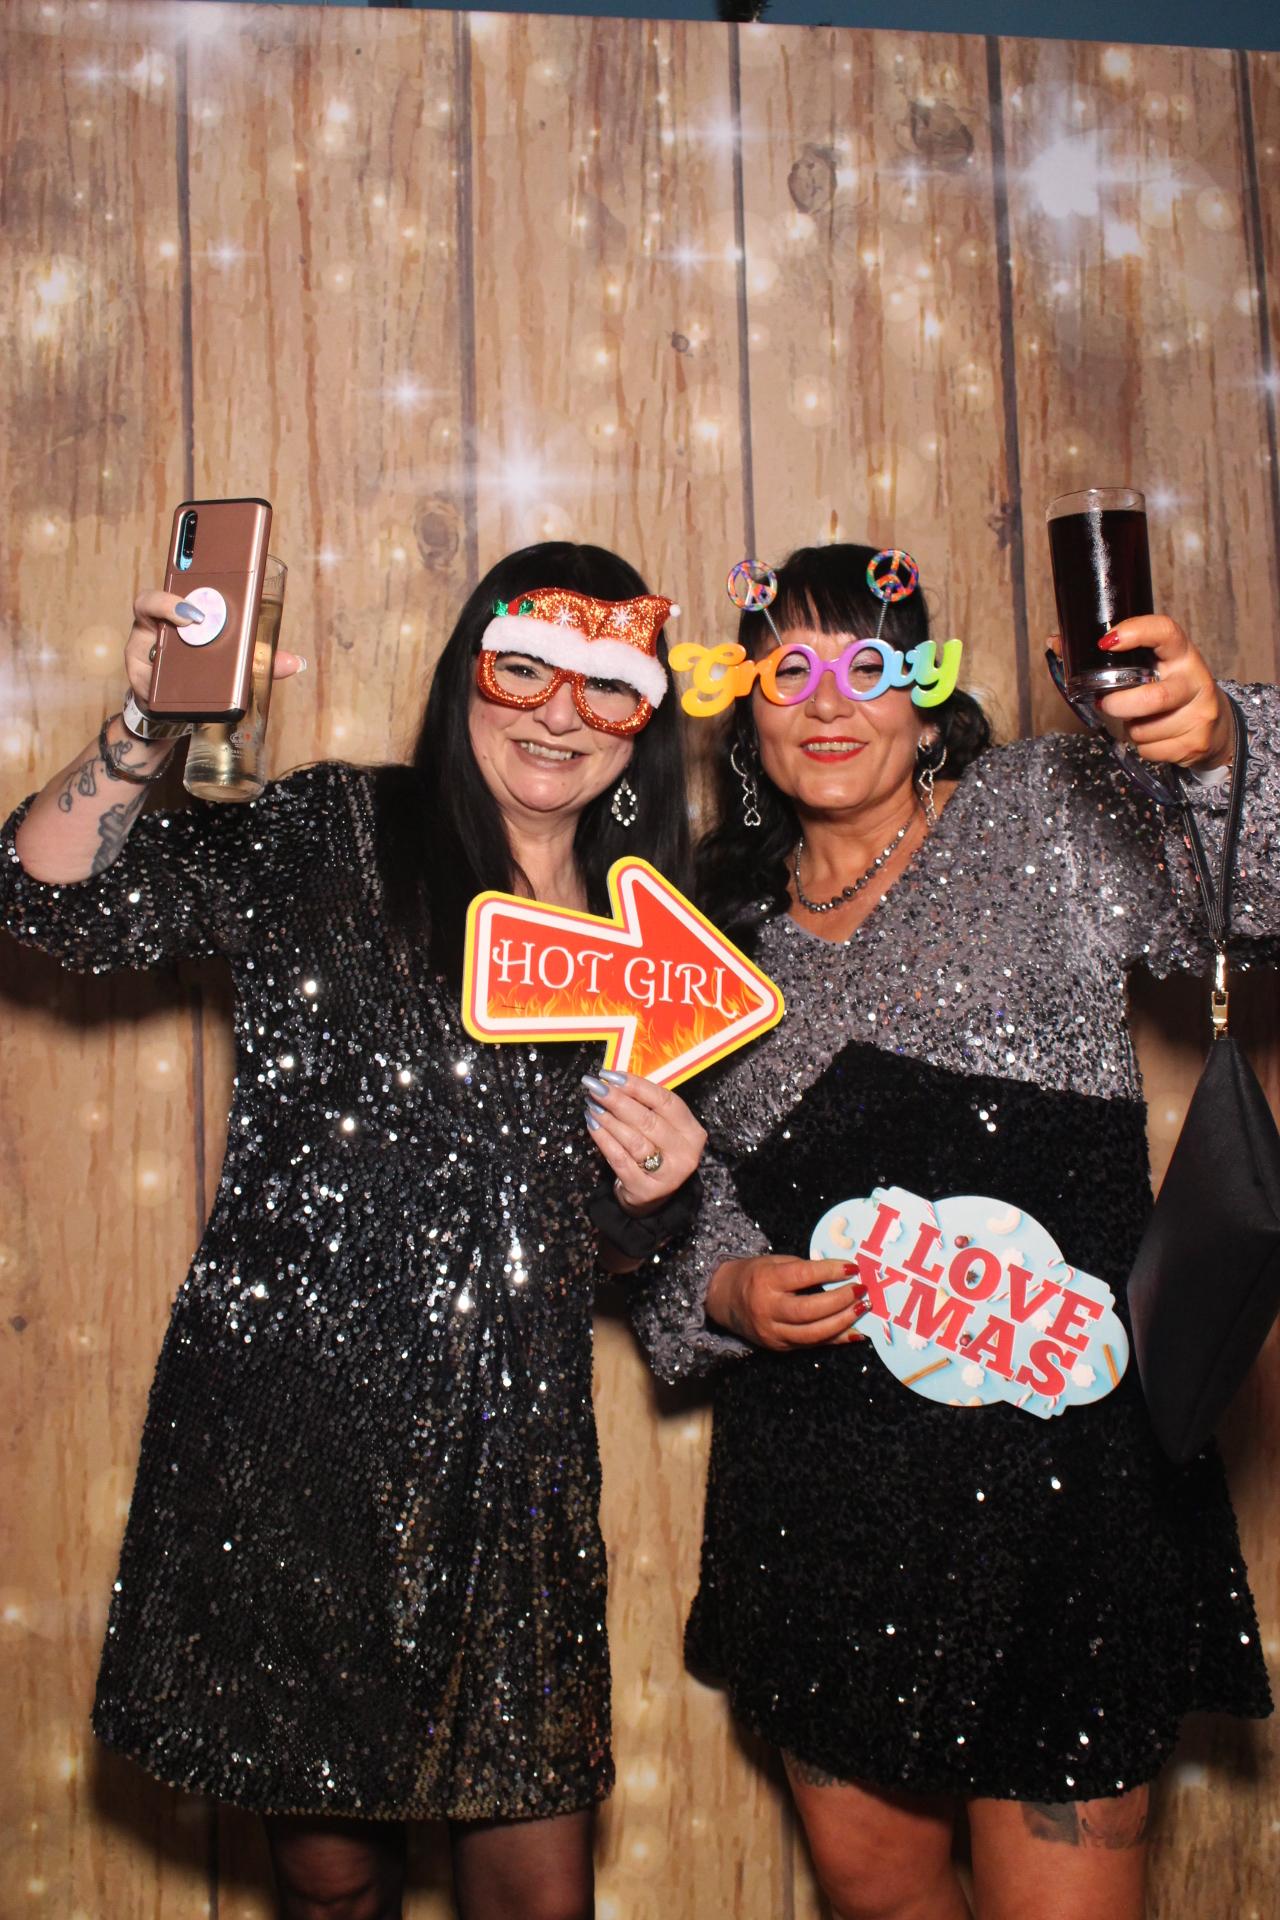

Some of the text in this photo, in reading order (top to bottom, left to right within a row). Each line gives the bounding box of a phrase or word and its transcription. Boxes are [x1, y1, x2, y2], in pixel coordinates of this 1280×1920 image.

[492, 939, 738, 1019] HOT GIRL
[854, 1252, 1079, 1397] XMAS
[859, 1202, 1105, 1352] I LOVE
